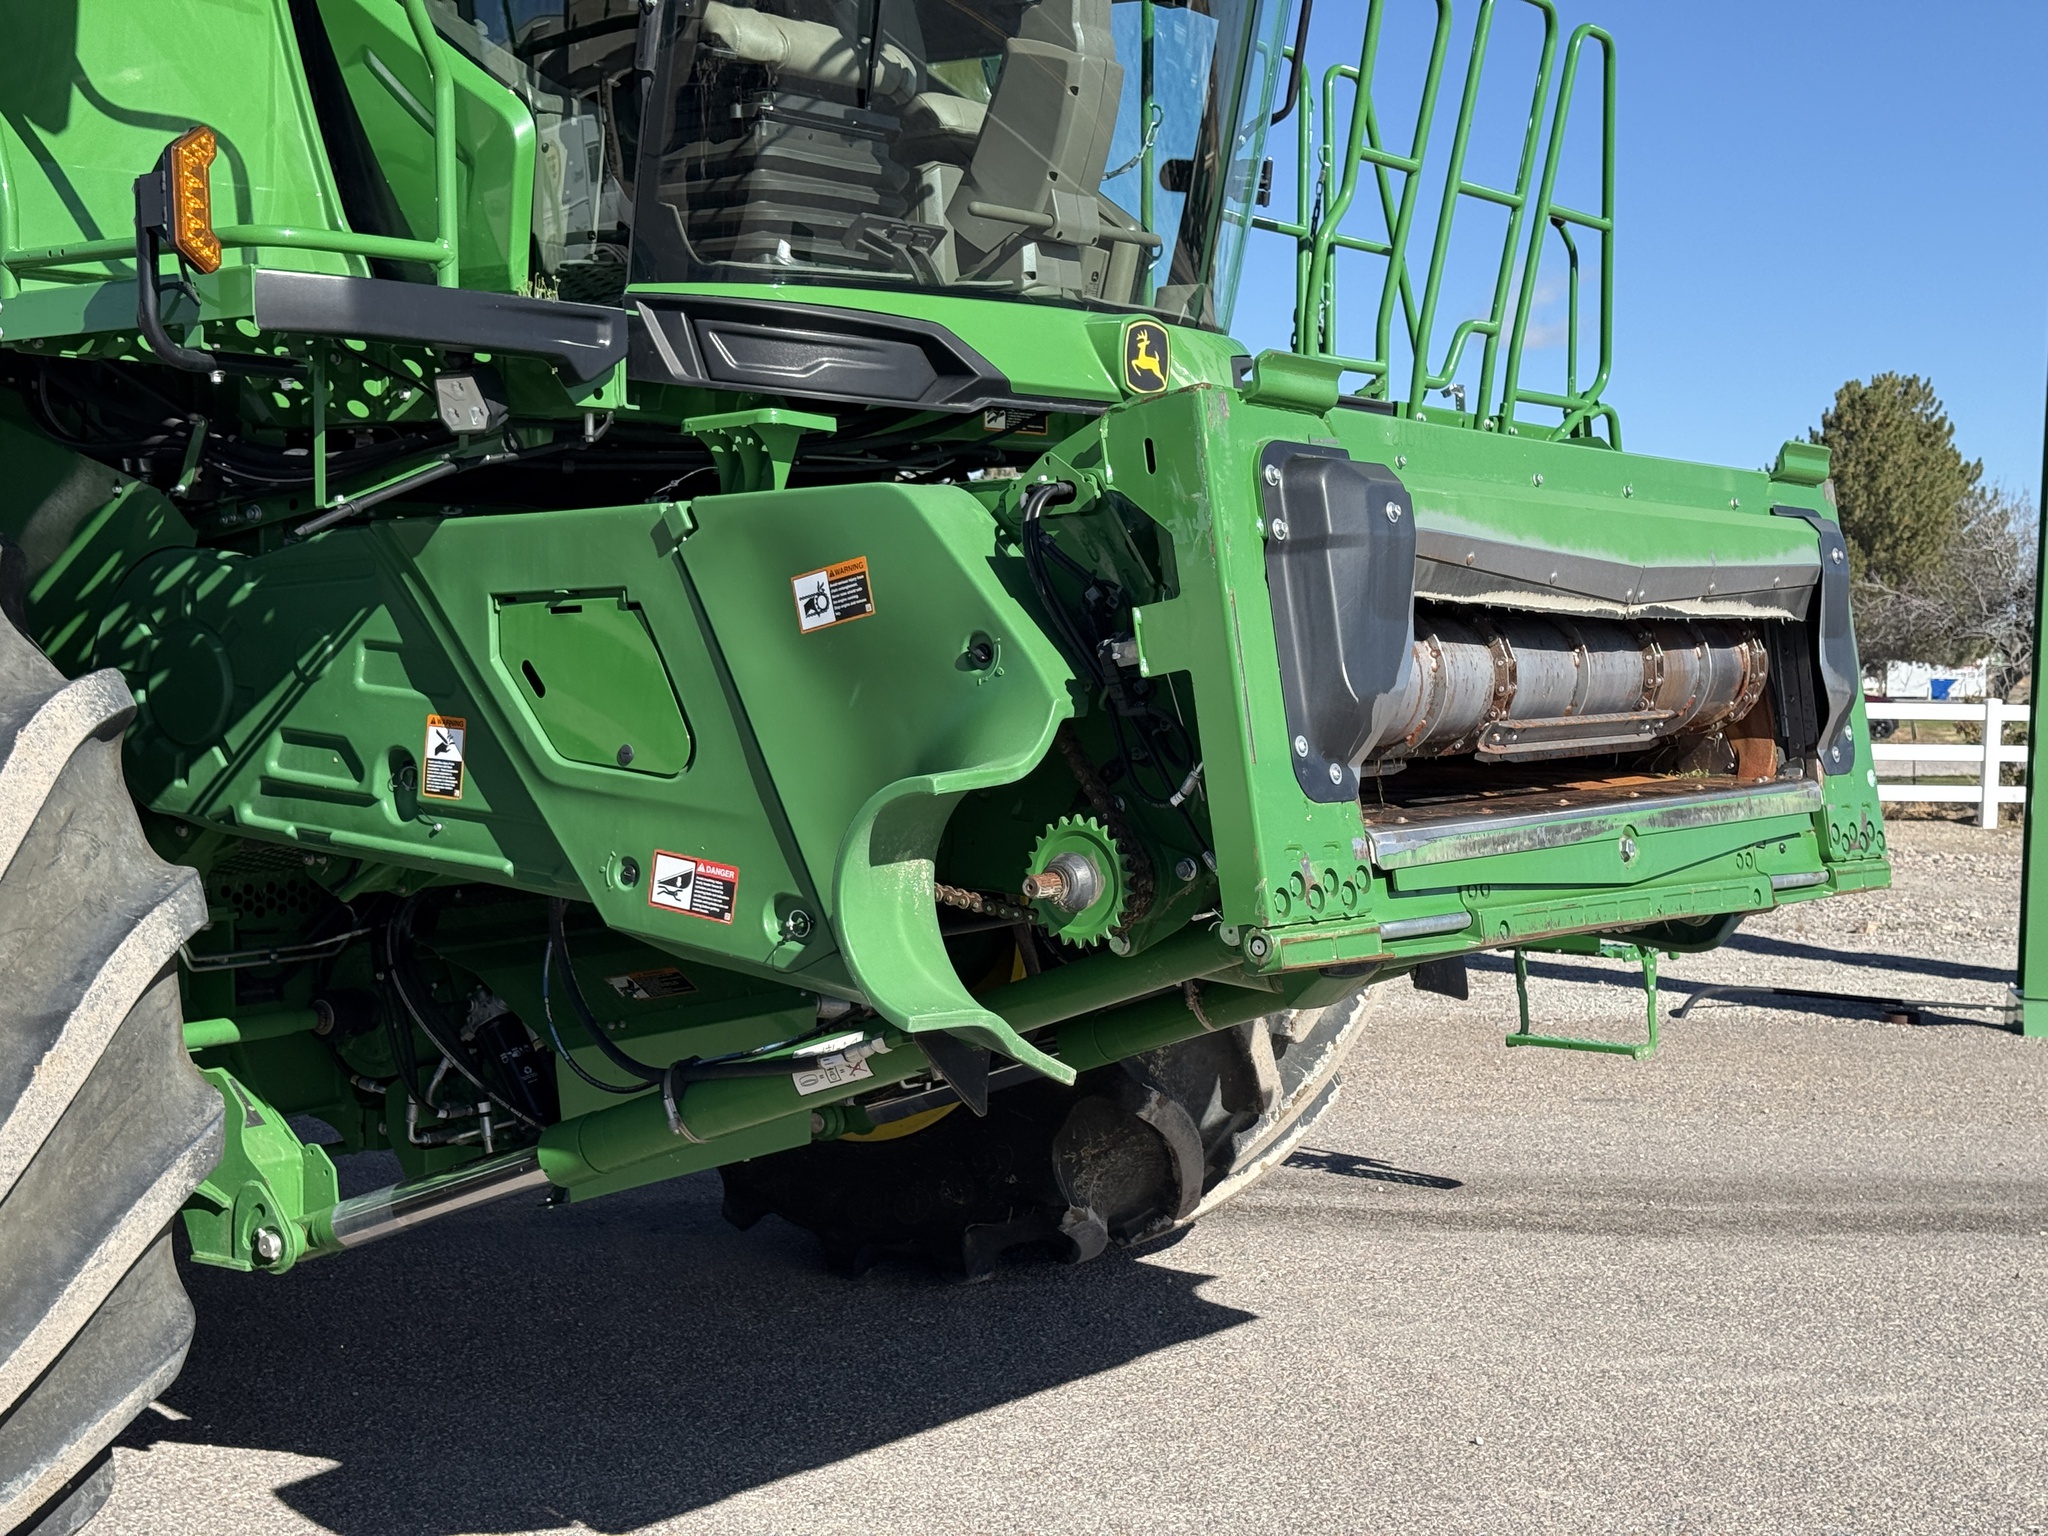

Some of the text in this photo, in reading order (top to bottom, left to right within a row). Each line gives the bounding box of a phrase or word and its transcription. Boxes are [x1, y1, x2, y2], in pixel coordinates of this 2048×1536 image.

[834, 562, 864, 576] WARNING
[437, 718, 464, 728] WARNING
[706, 865, 735, 879] DANGER
